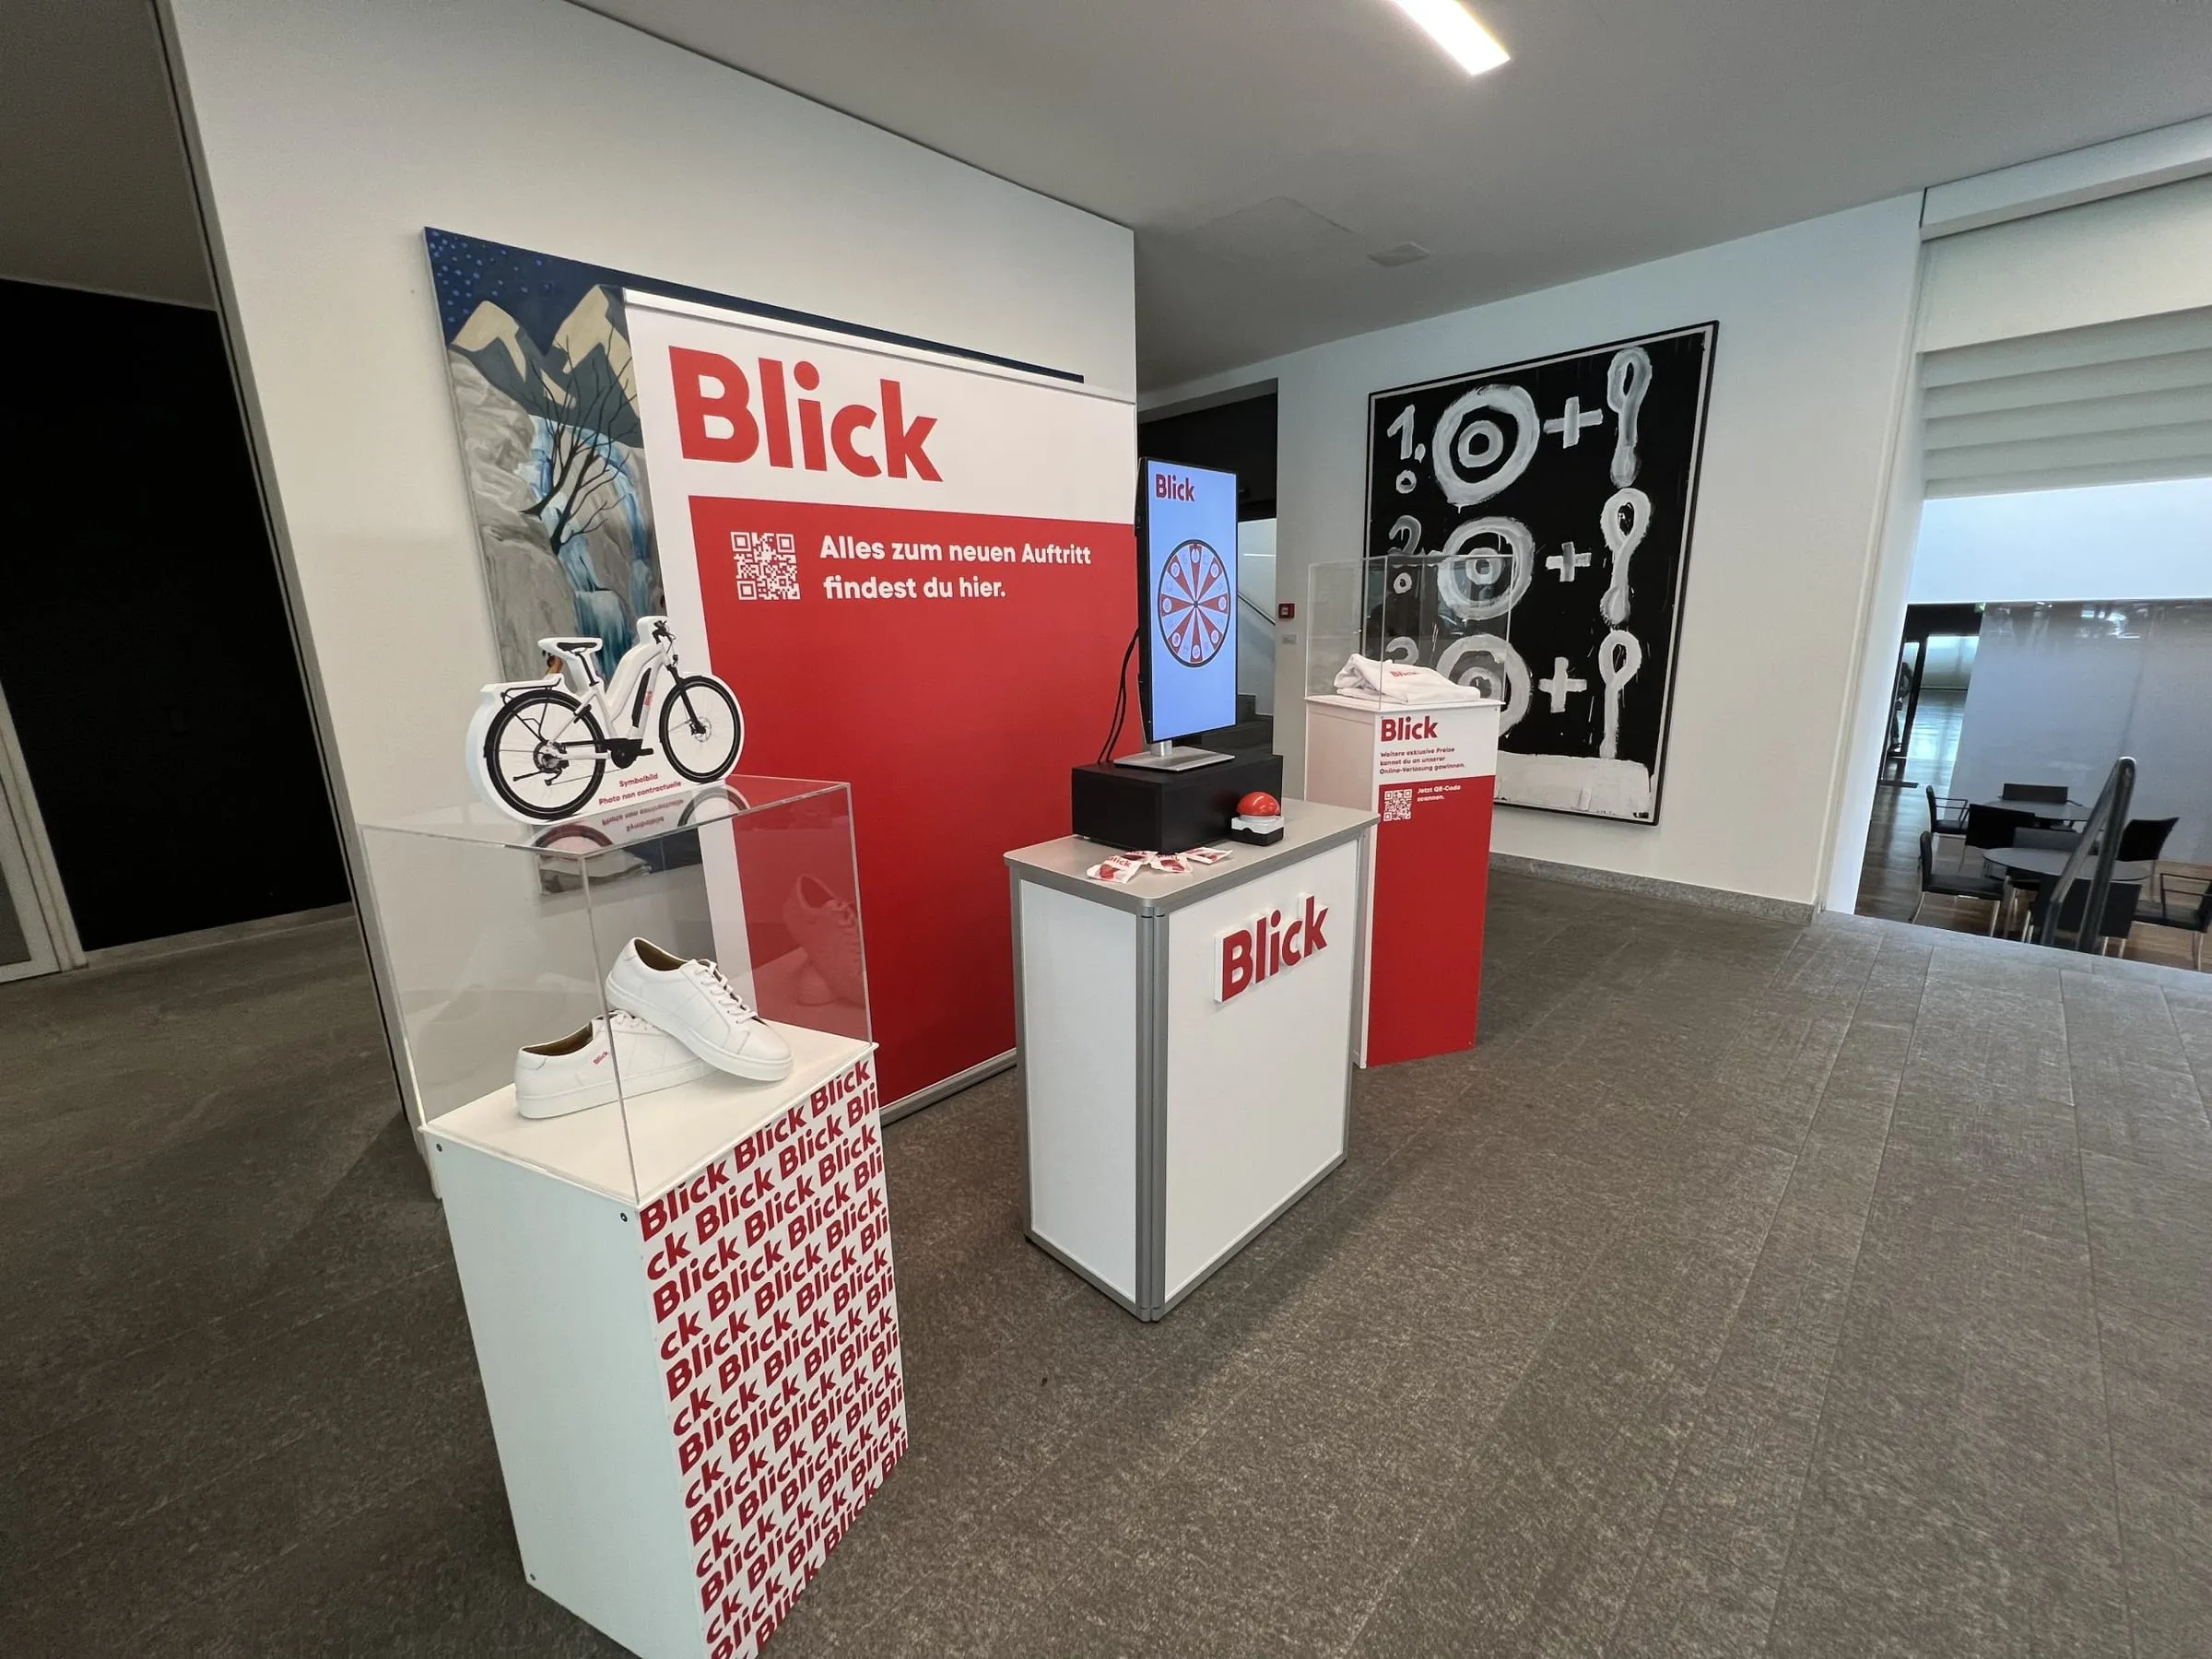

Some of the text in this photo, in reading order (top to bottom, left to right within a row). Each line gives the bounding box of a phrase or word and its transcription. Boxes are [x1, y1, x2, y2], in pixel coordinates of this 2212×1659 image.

[669, 346, 944, 482] Blick
[820, 535, 1091, 564] Alles zum neuen Auftritt
[1156, 474, 1195, 501] Blick
[823, 575, 1006, 599] findest du hier.
[598, 795, 621, 806] Photo
[622, 792, 636, 800] non
[619, 773, 658, 787] Symbolbild
[1381, 715, 1438, 742] Blick
[1406, 747, 1435, 756] exklusive
[1222, 895, 1329, 1002] Blick
[640, 1061, 870, 1241] Blick Blick Blick
[695, 1166, 774, 1245] Blick
[779, 1113, 843, 1180] Blick
[653, 1124, 877, 1324] Blick Blick Blick
[666, 1187, 882, 1401] Blick Blick Blick
[708, 1240, 784, 1321] Blick
[788, 1181, 850, 1251] Blick
[678, 1249, 888, 1475] Blick Blick Blick
[719, 1309, 792, 1394] Blick
[796, 1245, 857, 1316] Blick
[729, 1376, 799, 1463] Blick
[804, 1308, 863, 1381] Blick
[690, 1306, 892, 1545] Blick Blick Blick
[701, 1363, 898, 1612] Blick Blick Blick
[738, 1438, 807, 1530] Blick
[811, 1367, 868, 1443] Blick
[712, 1418, 901, 1659] Blick Blick Blick
[747, 1501, 814, 1593] Blick
[818, 1423, 874, 1502] Blick
